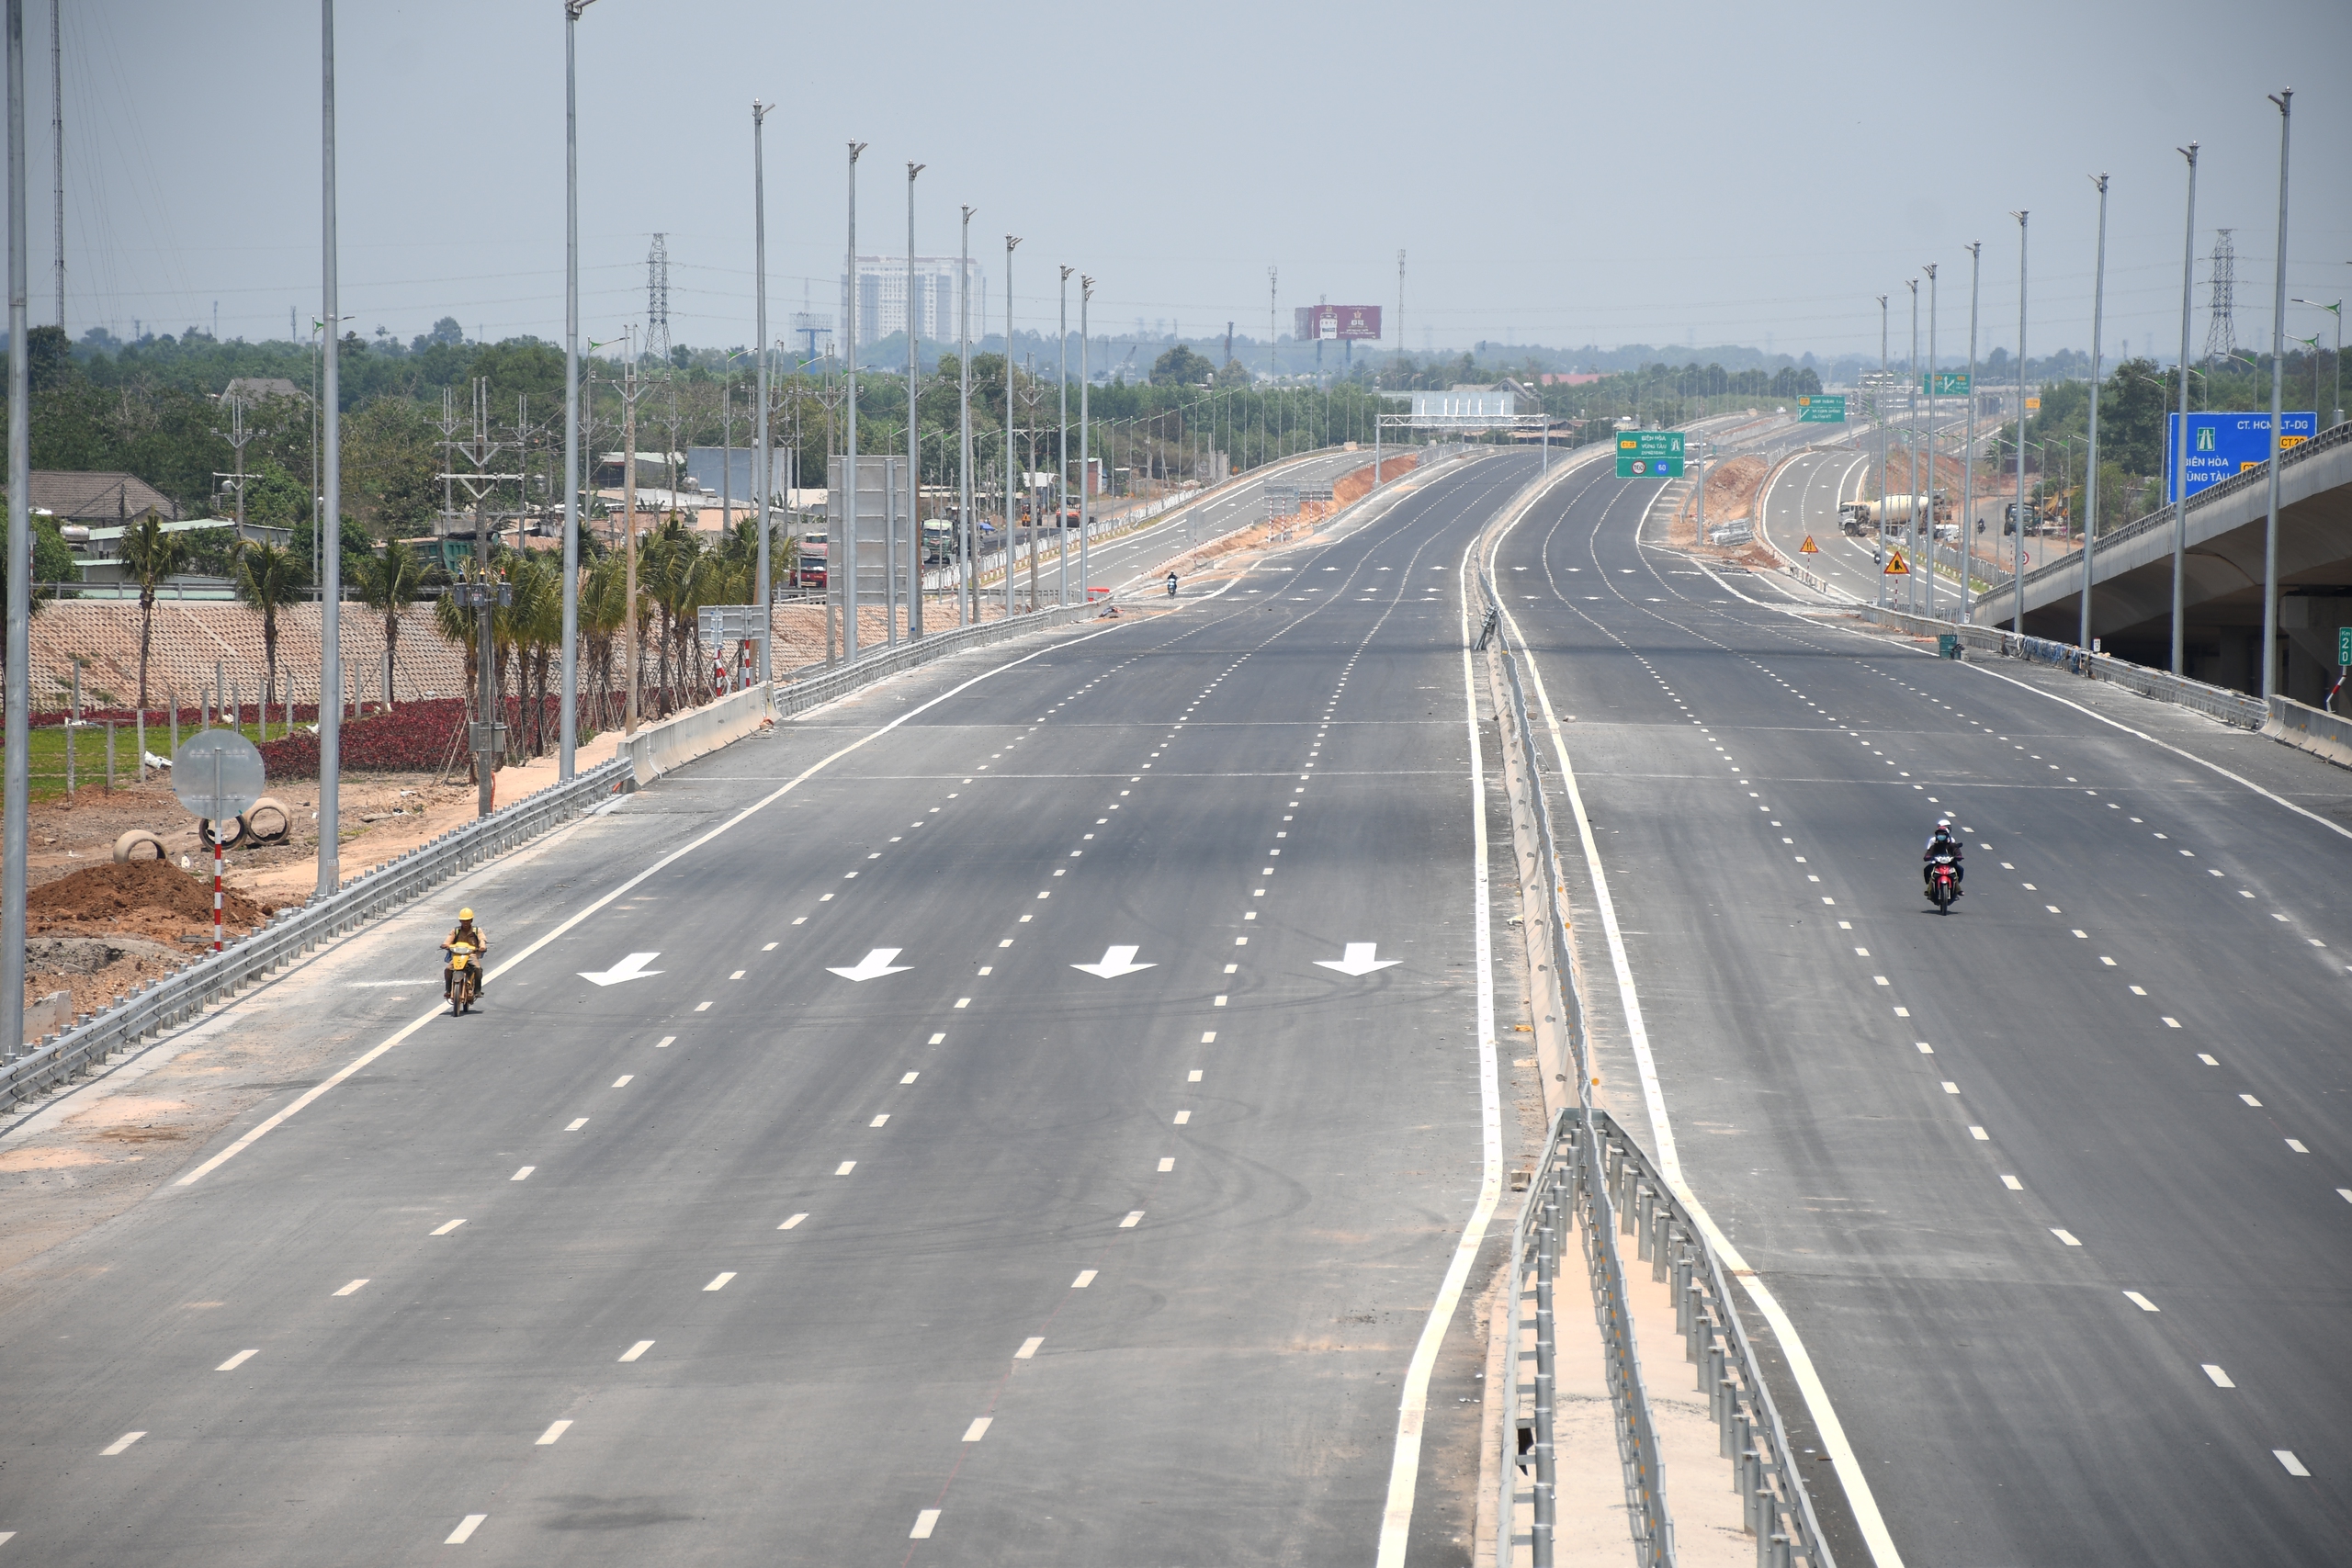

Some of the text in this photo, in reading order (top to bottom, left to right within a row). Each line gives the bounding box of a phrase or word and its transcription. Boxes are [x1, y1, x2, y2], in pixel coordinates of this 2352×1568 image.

[2237, 420, 2308, 430] CT. HCMLT-DG
[2185, 456, 2229, 467] BIÊN HÒA
[2186, 470, 2208, 482] ŨNG
